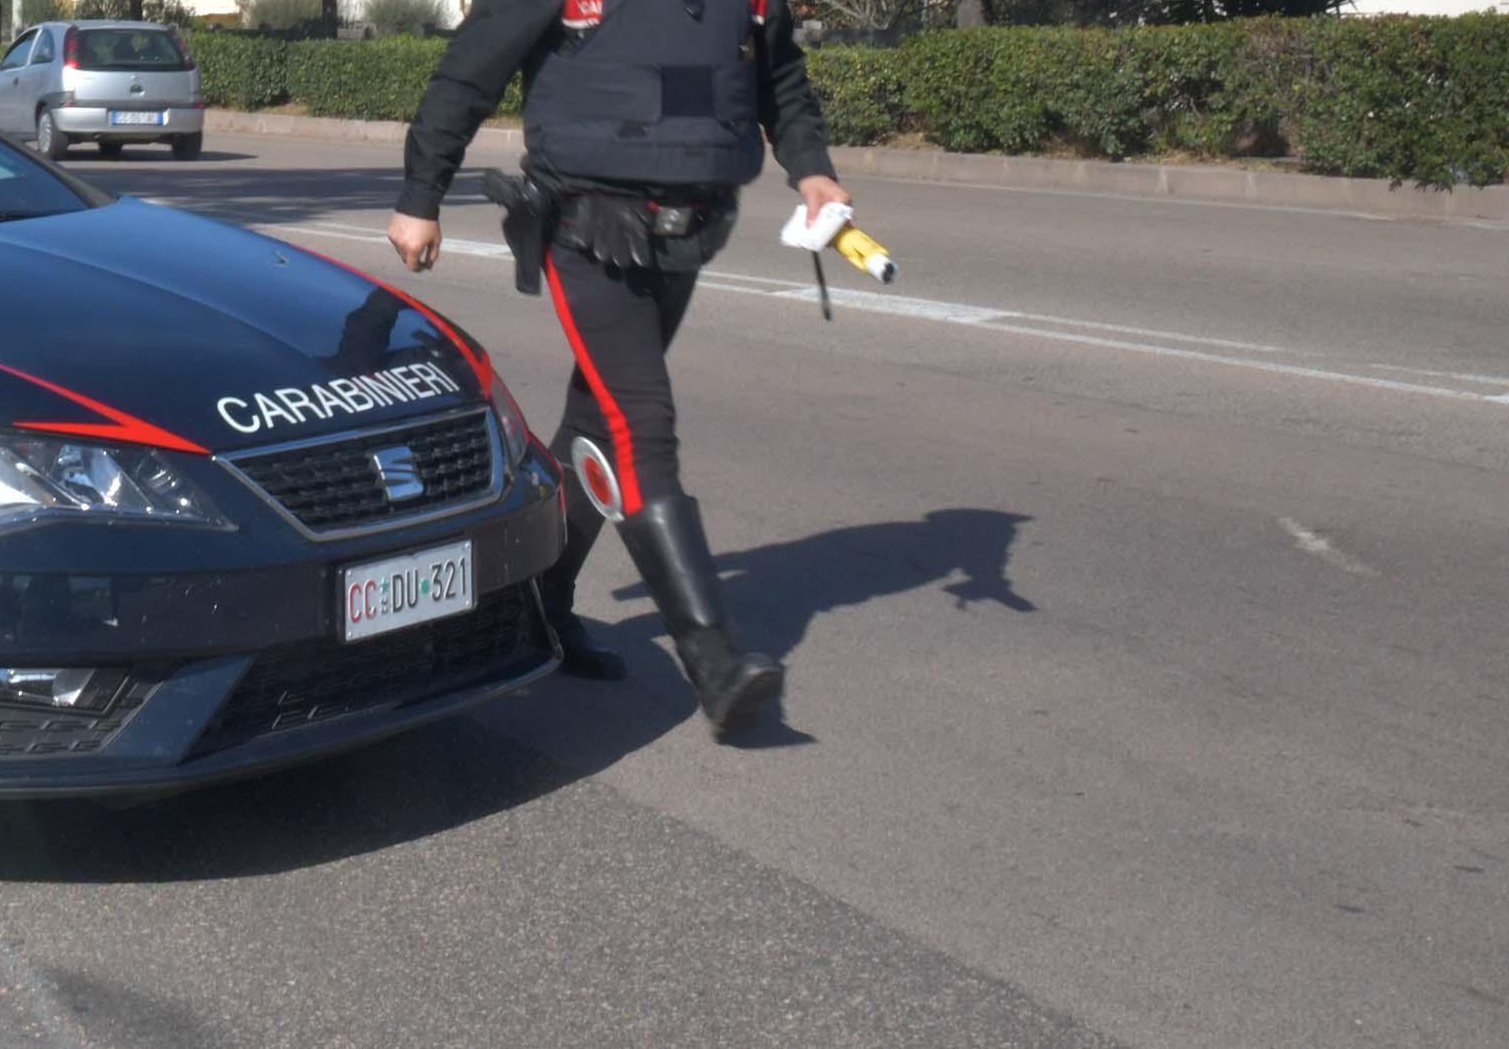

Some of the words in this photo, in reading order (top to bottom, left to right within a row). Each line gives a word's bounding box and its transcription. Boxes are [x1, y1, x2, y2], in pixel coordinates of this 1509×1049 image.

[216, 361, 460, 433] CARABINIERI
[348, 579, 377, 624] CC
[429, 556, 467, 602] 321
